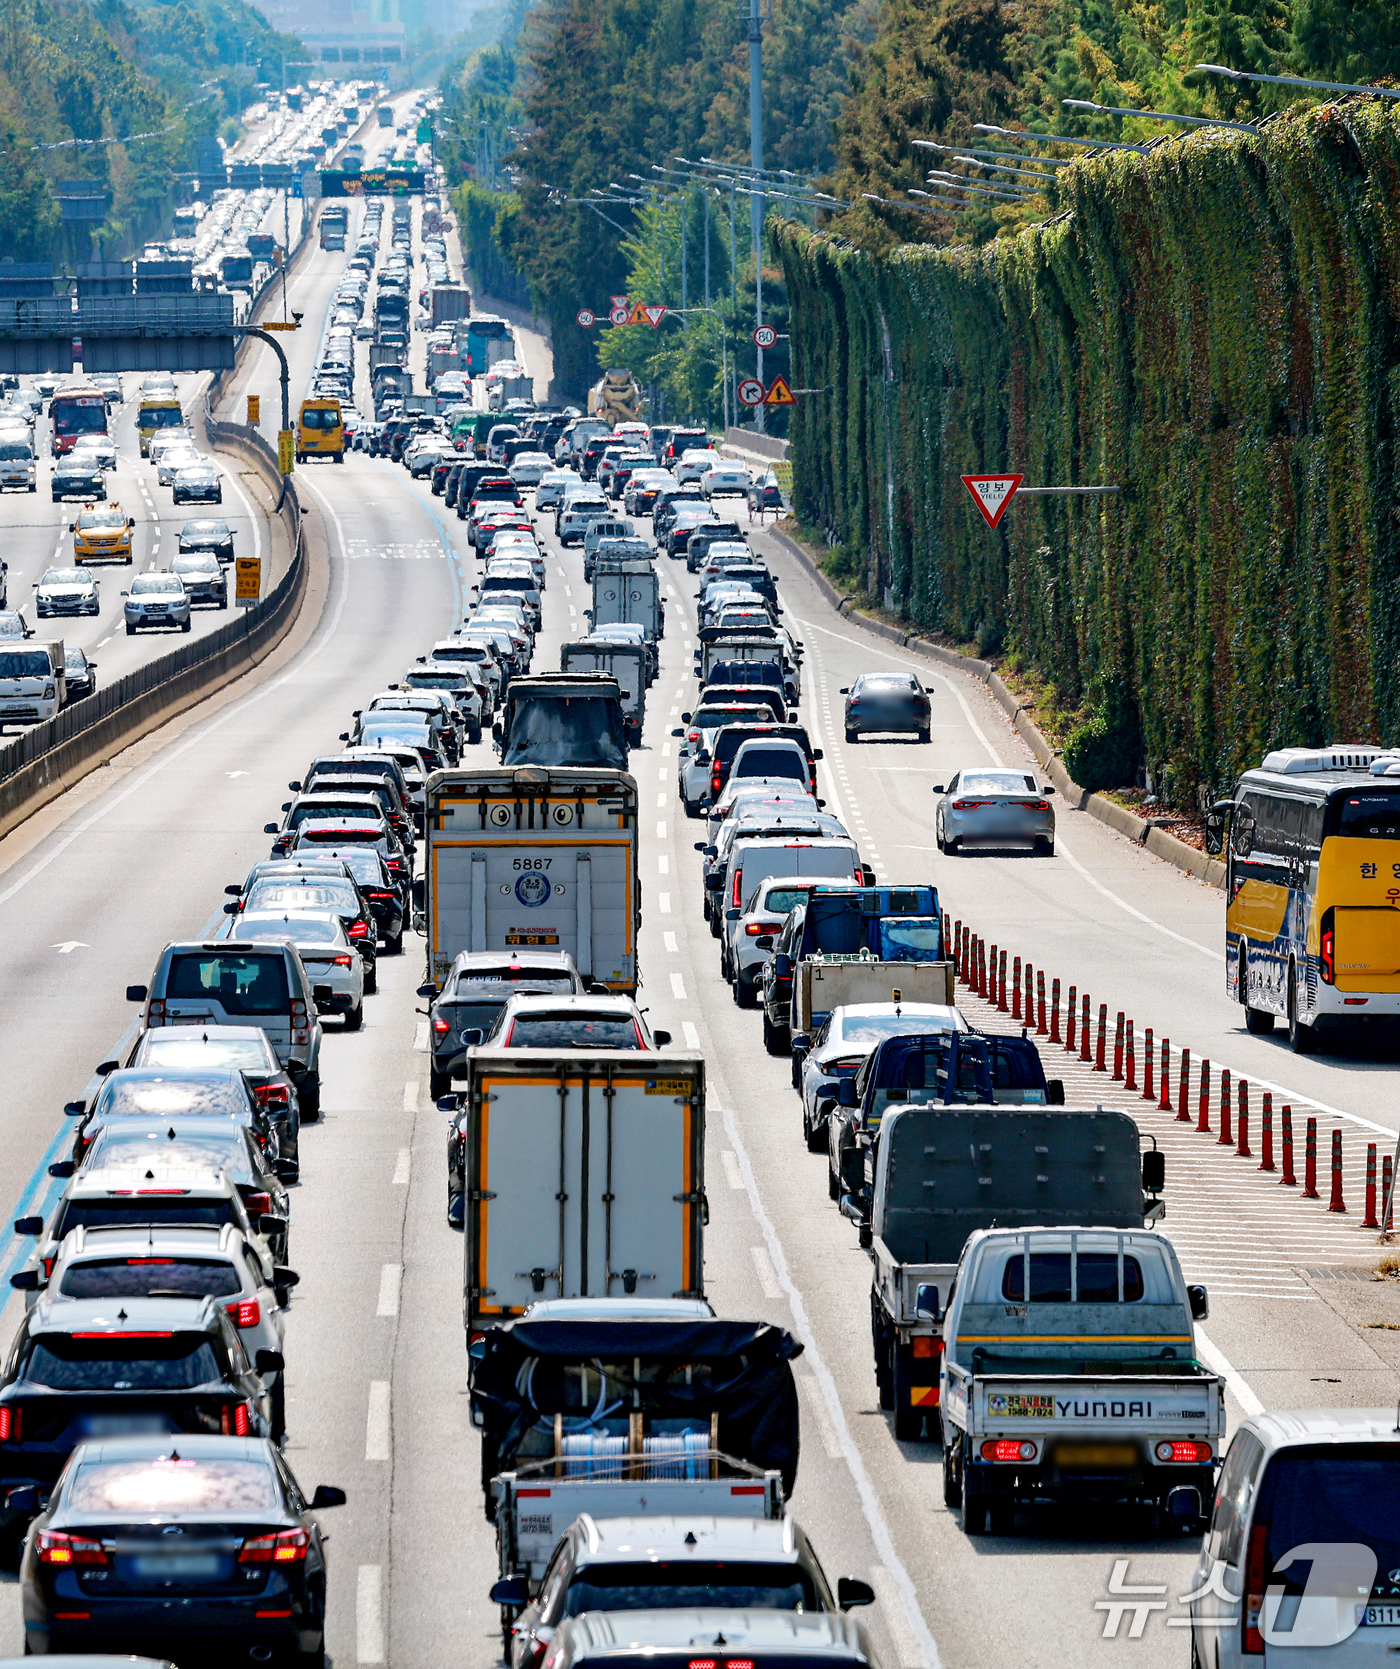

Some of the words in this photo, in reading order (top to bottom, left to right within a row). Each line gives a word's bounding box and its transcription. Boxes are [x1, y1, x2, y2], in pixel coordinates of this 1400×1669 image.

[758, 331, 773, 343] 80
[978, 482, 1006, 493] 양보
[513, 859, 552, 870] 5867
[815, 969, 824, 980] 1
[1008, 1408, 1053, 1417] 1588-7924
[1368, 1608, 1400, 1623] 811
